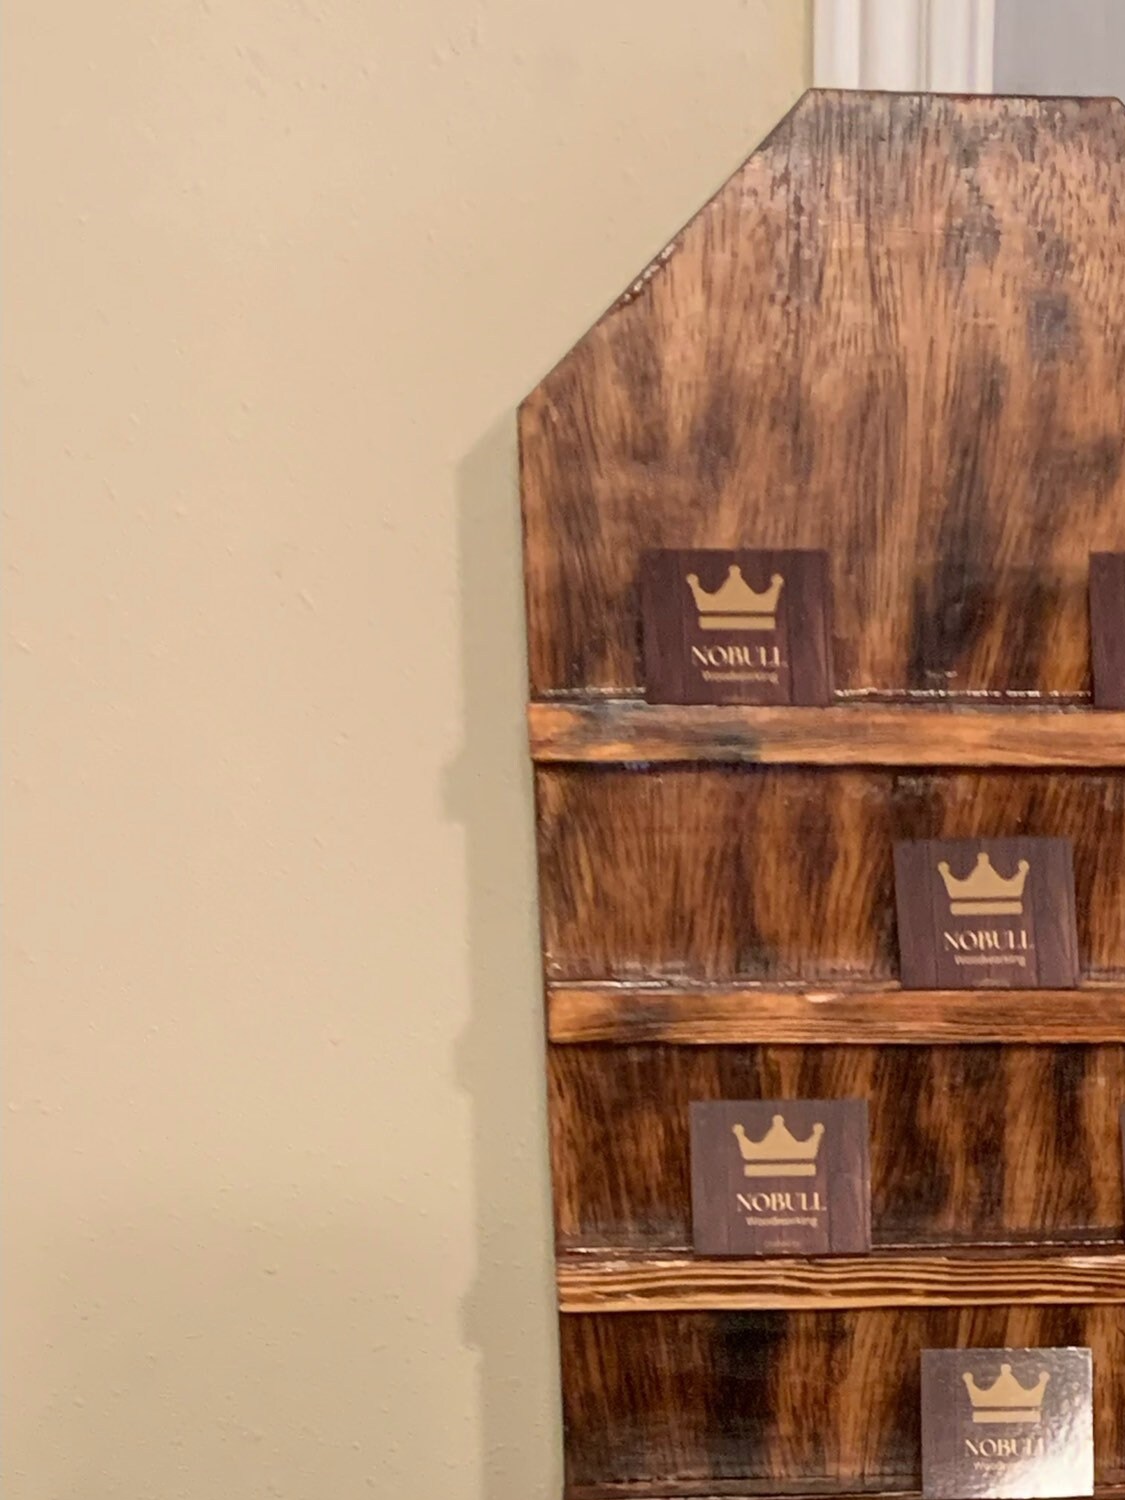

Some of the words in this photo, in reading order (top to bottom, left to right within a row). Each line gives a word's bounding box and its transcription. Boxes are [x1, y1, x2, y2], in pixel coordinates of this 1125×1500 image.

[691, 645, 789, 667] NOBULL
[943, 929, 1034, 951] NOBULL
[736, 1192, 828, 1212] NOBULL
